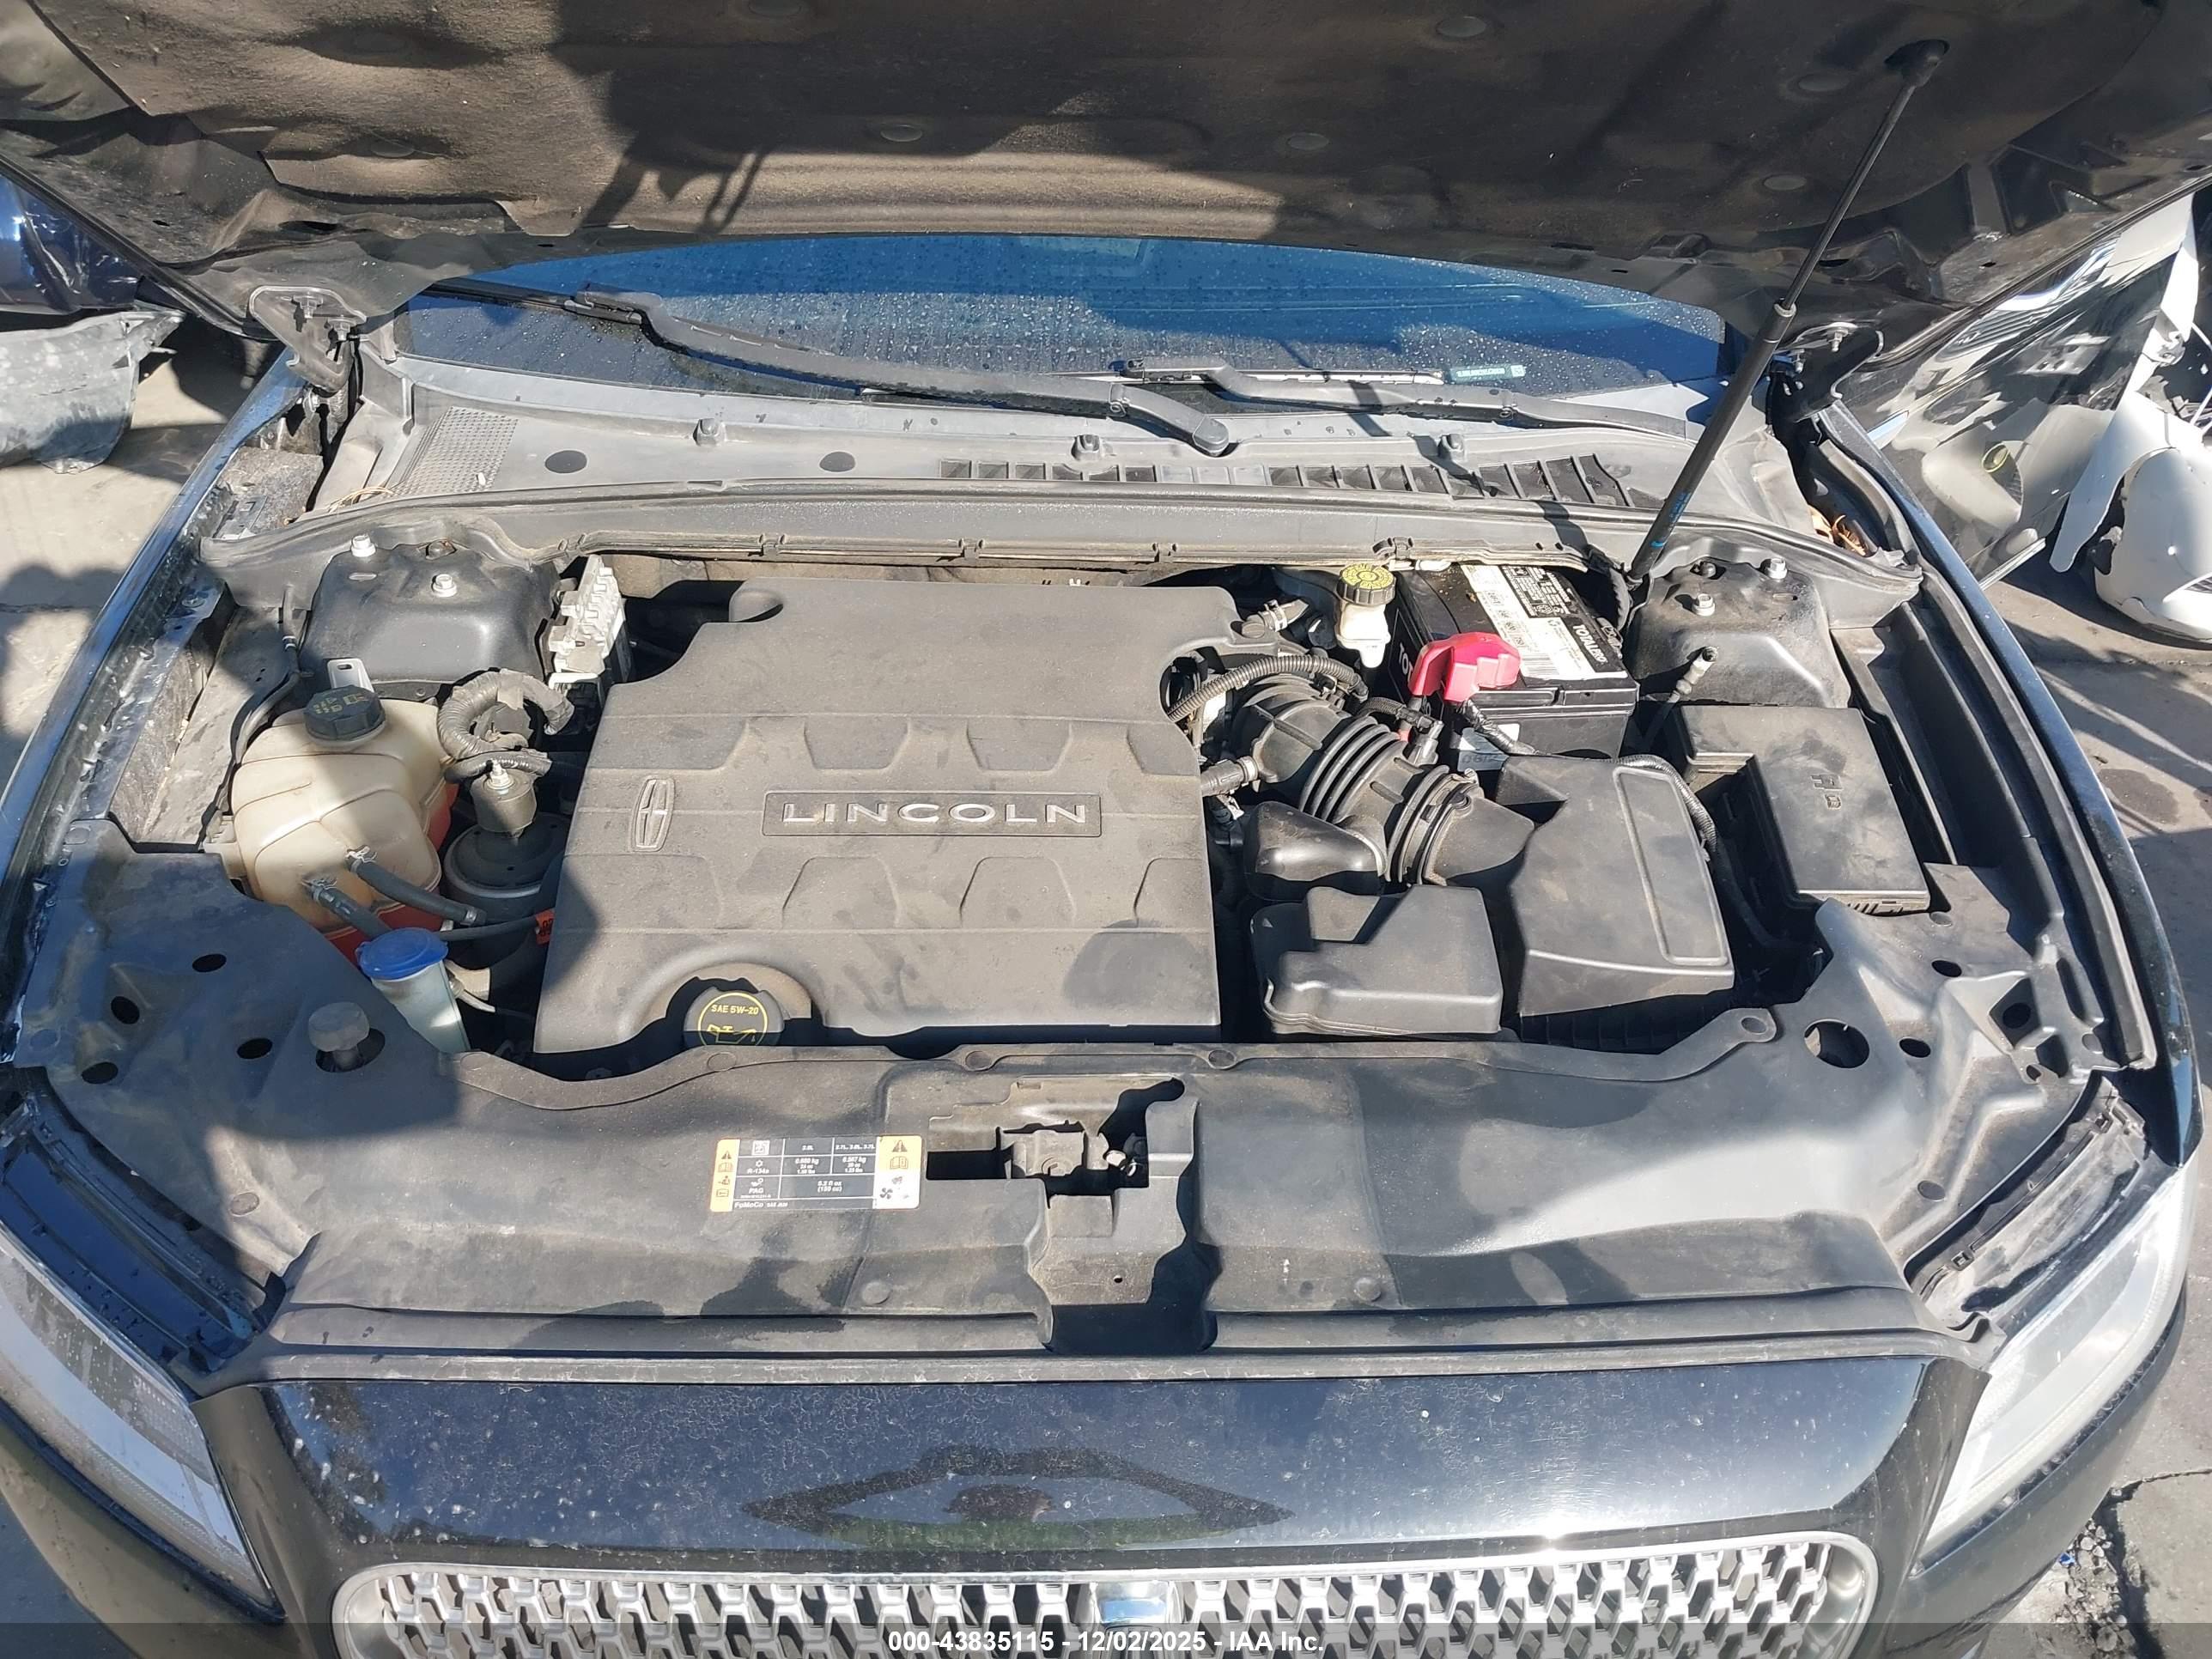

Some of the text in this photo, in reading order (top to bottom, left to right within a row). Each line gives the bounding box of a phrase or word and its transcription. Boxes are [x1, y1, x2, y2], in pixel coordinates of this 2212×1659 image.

[1572, 624, 1607, 663] TOTALPRO
[781, 802, 1087, 824] LINCOLN
[711, 1004, 759, 1015] SAE 5W-20
